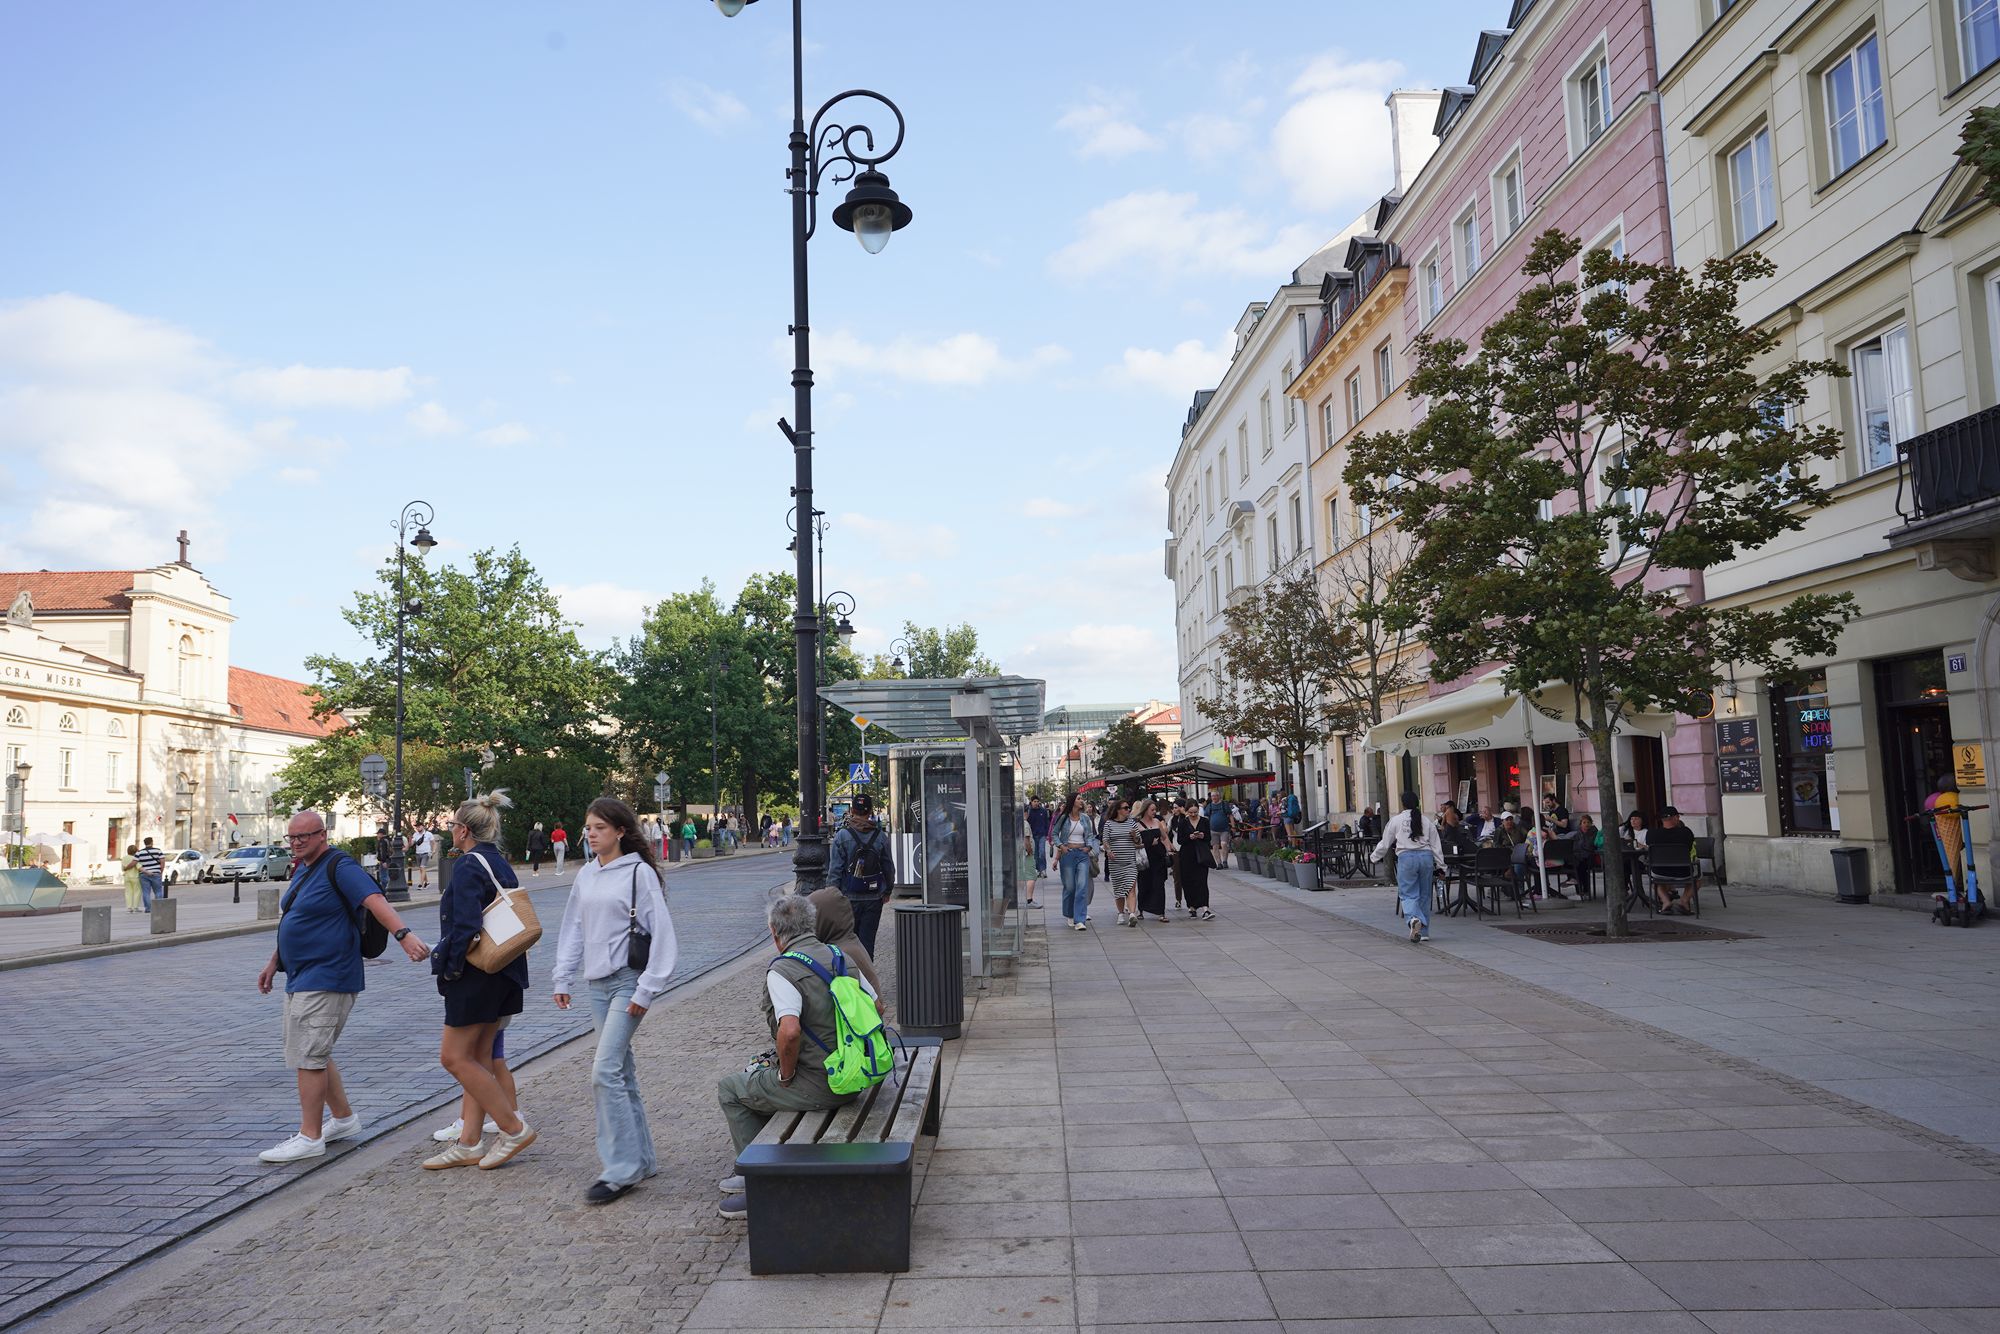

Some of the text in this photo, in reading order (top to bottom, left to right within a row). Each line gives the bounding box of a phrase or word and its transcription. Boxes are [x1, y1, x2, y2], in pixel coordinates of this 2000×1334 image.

[1952, 659, 1962, 671] 61
[0, 666, 82, 687] CRA MISER
[1800, 708, 1830, 721] ZAPIEK
